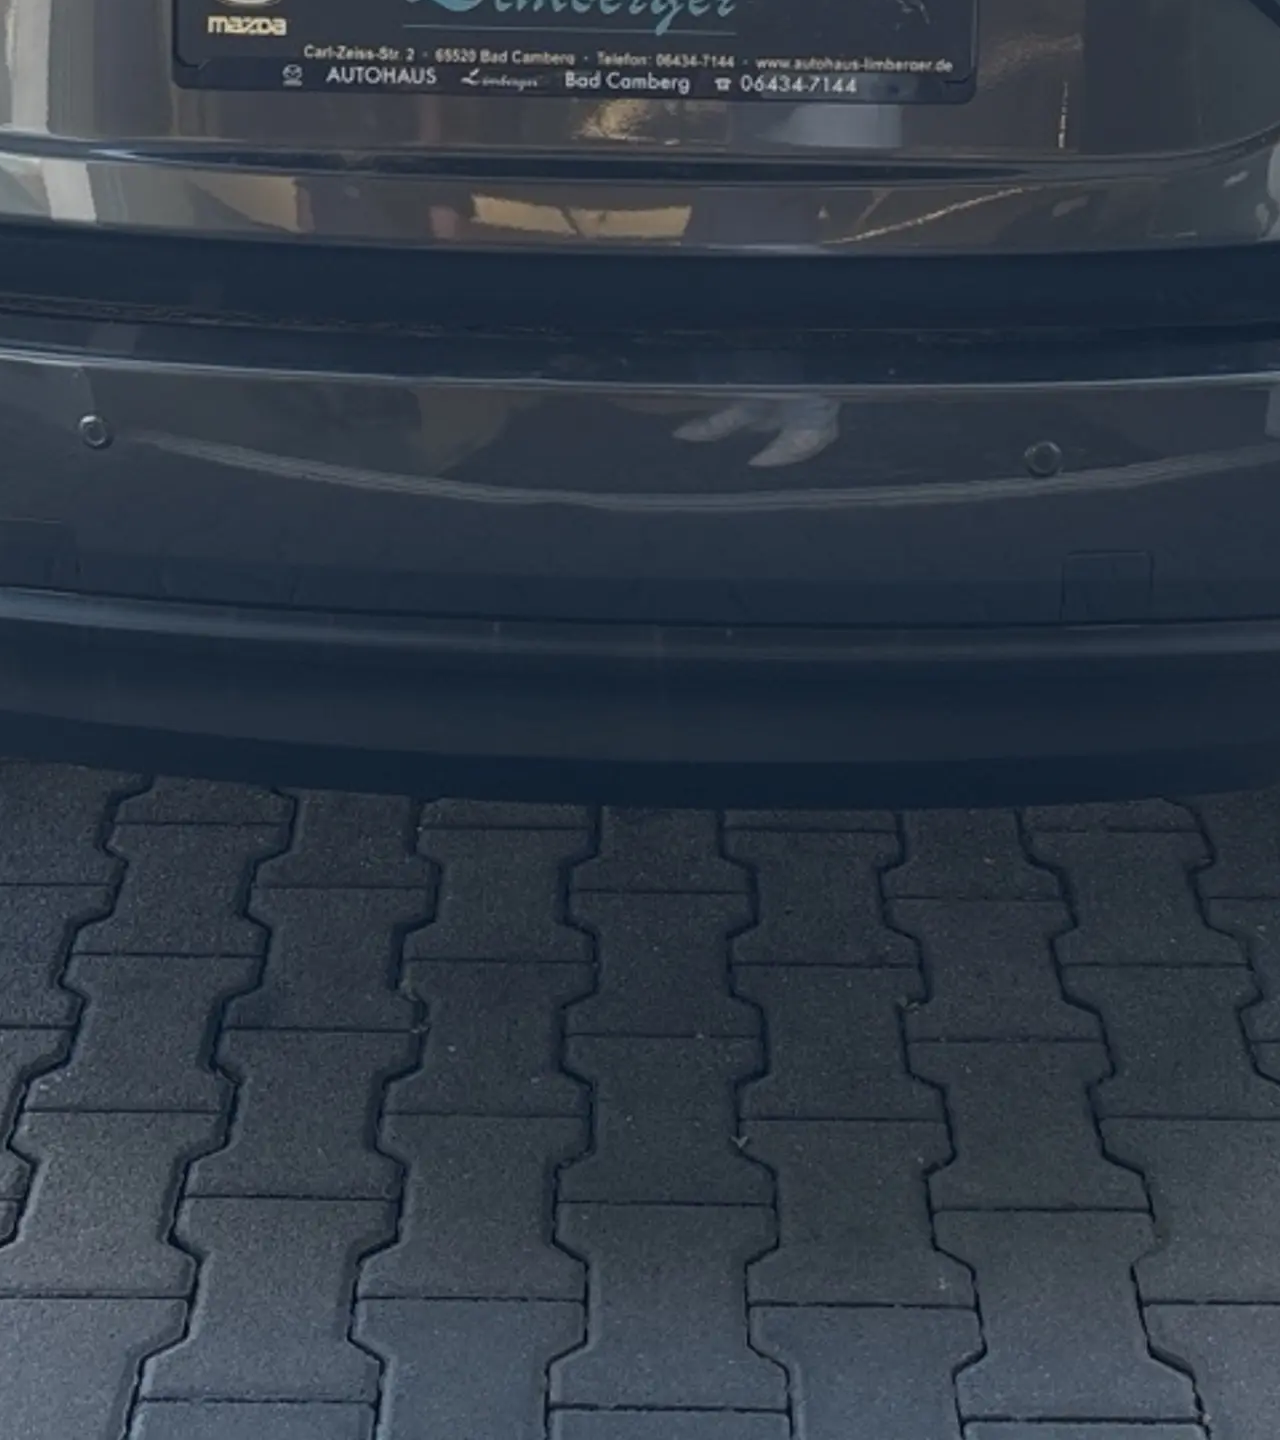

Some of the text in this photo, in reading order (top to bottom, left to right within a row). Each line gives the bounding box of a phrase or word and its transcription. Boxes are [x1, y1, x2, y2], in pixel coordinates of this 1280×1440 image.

[206, 15, 288, 36] mazda
[302, 44, 405, 62] Carl-Zeiss-Str.
[405, 47, 416, 62] 2
[479, 48, 509, 64] Bad
[511, 49, 576, 66] Camberg
[596, 50, 653, 67] Telefon:
[655, 53, 736, 68] 06434-7144
[325, 66, 438, 85] AUTOHAUS
[564, 71, 602, 89] Bad
[605, 71, 690, 95] Camberg
[740, 75, 858, 94] 06434-7144
